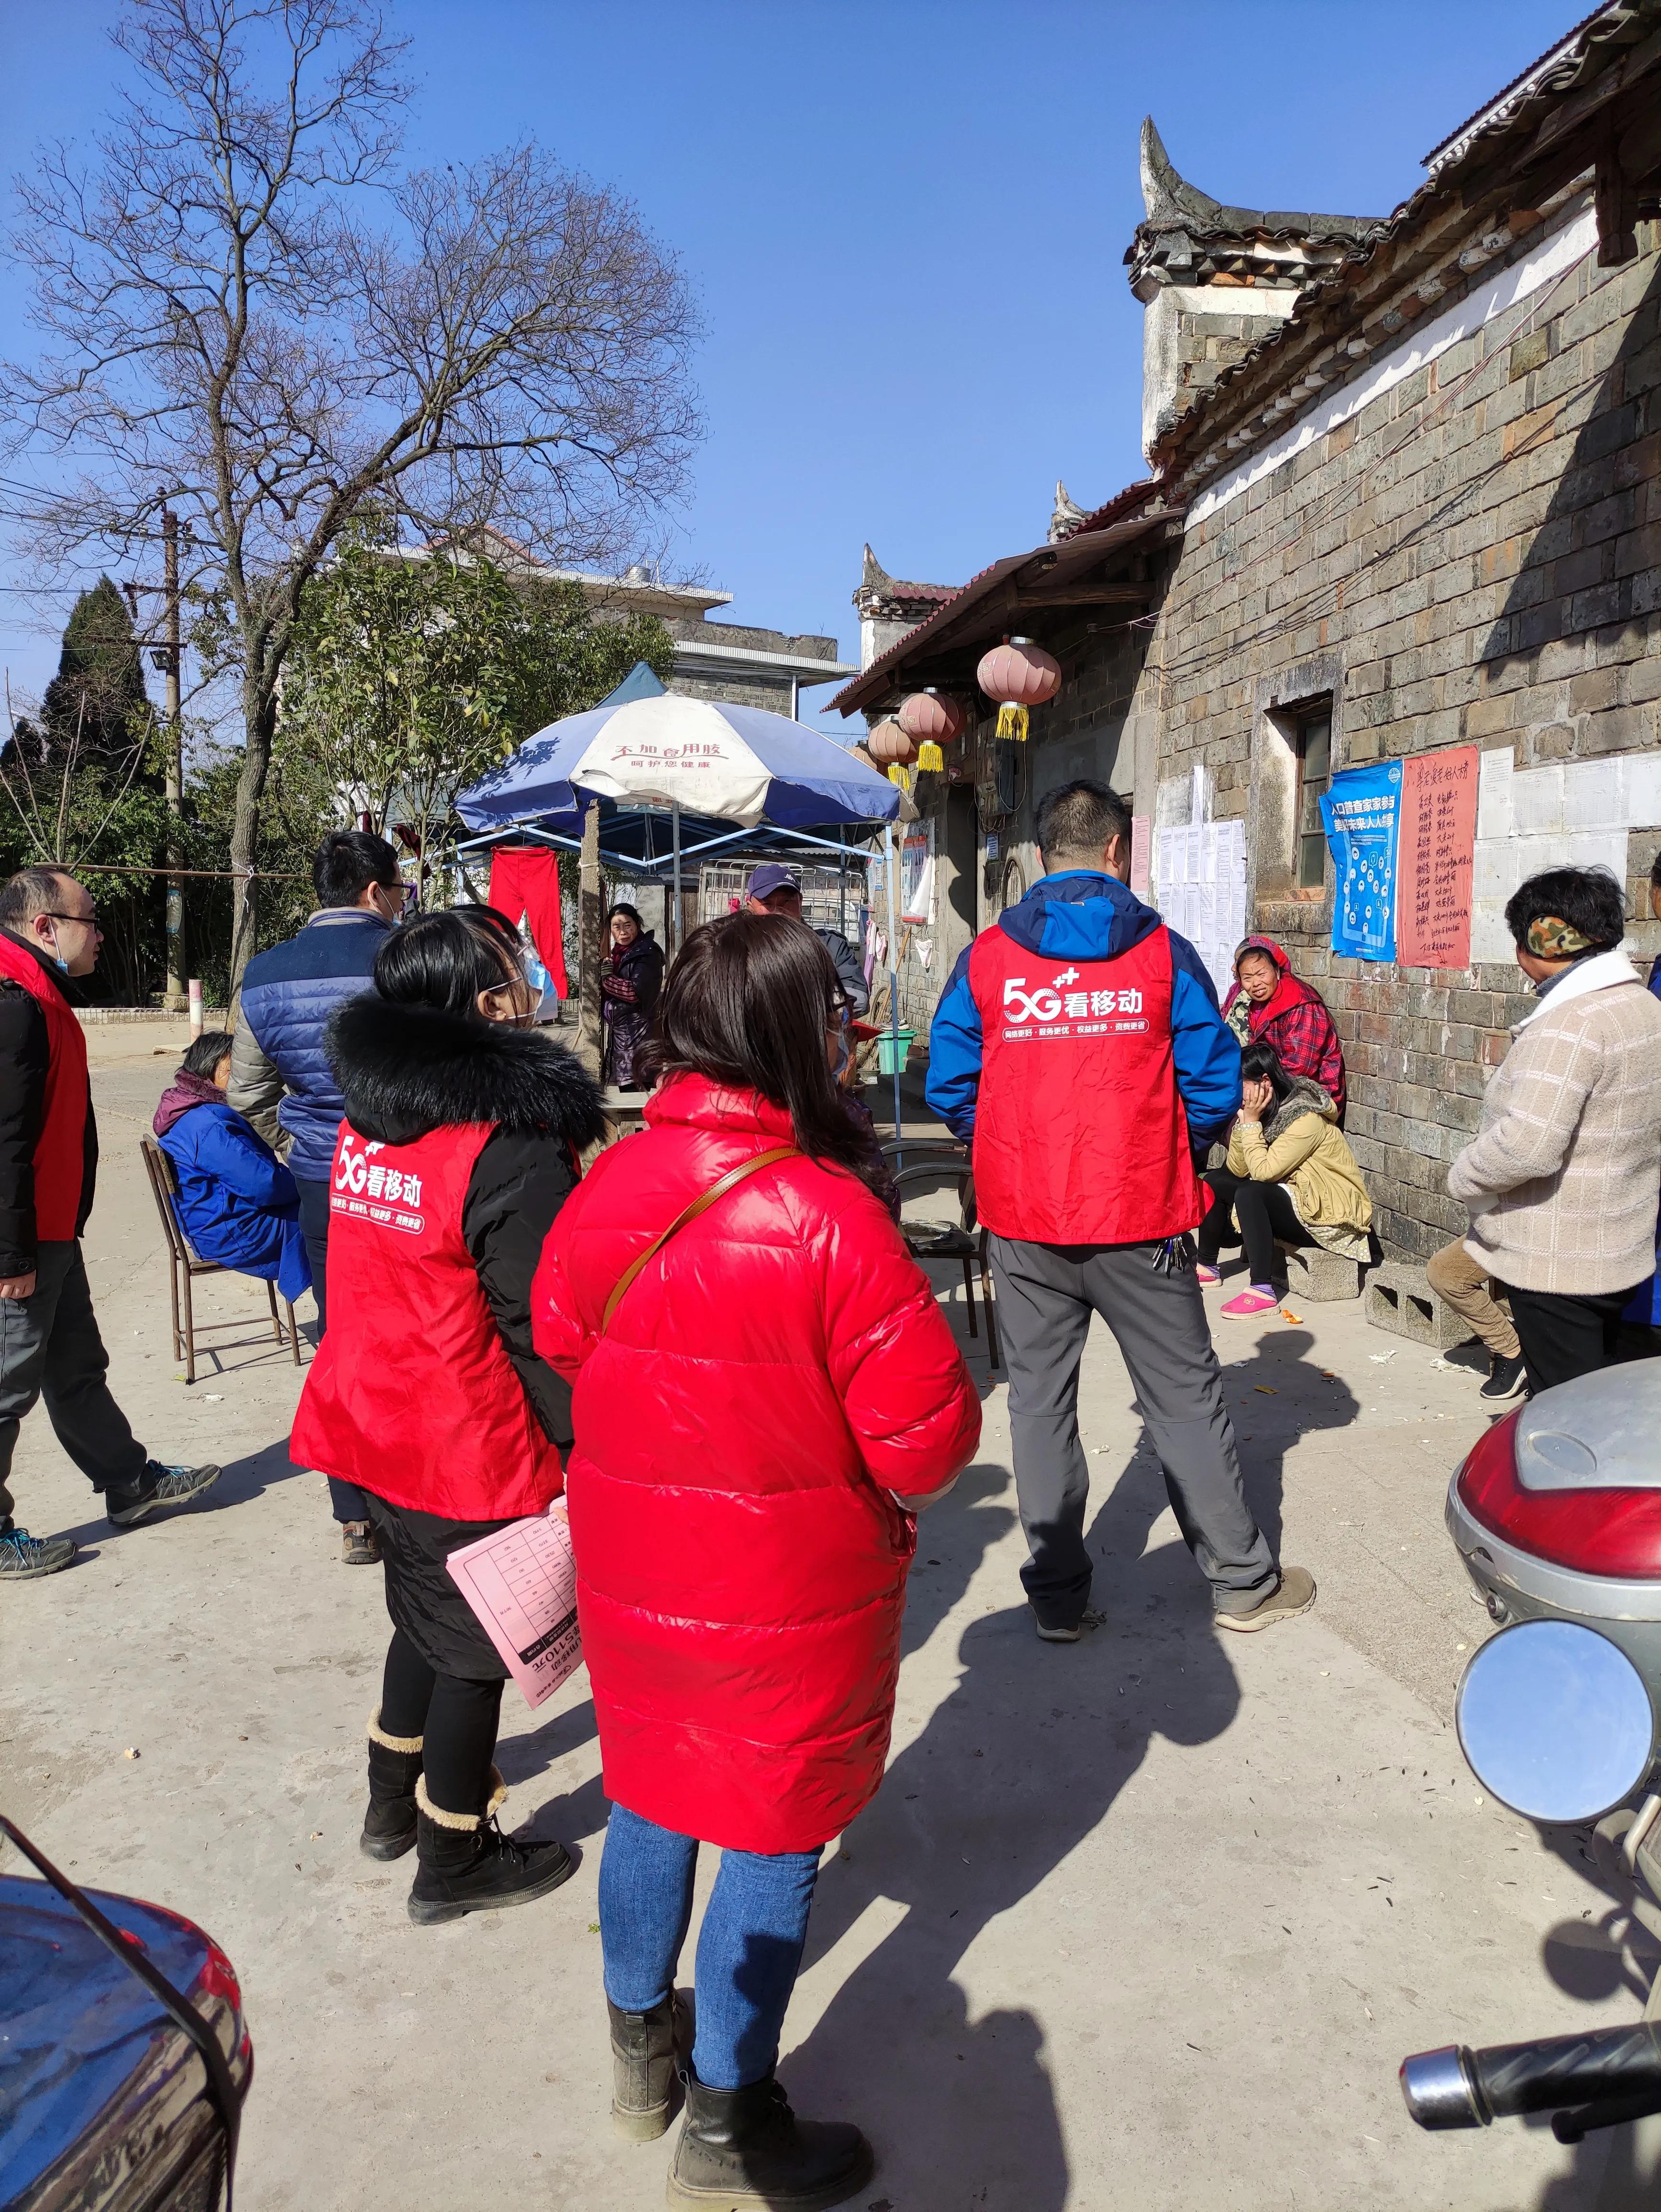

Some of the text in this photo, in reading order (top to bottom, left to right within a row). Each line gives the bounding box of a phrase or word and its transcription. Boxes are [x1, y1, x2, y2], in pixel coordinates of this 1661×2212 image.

[1331, 795, 1395, 816] 人口普查家家参与
[1334, 813, 1395, 832] 美好未来人人共享
